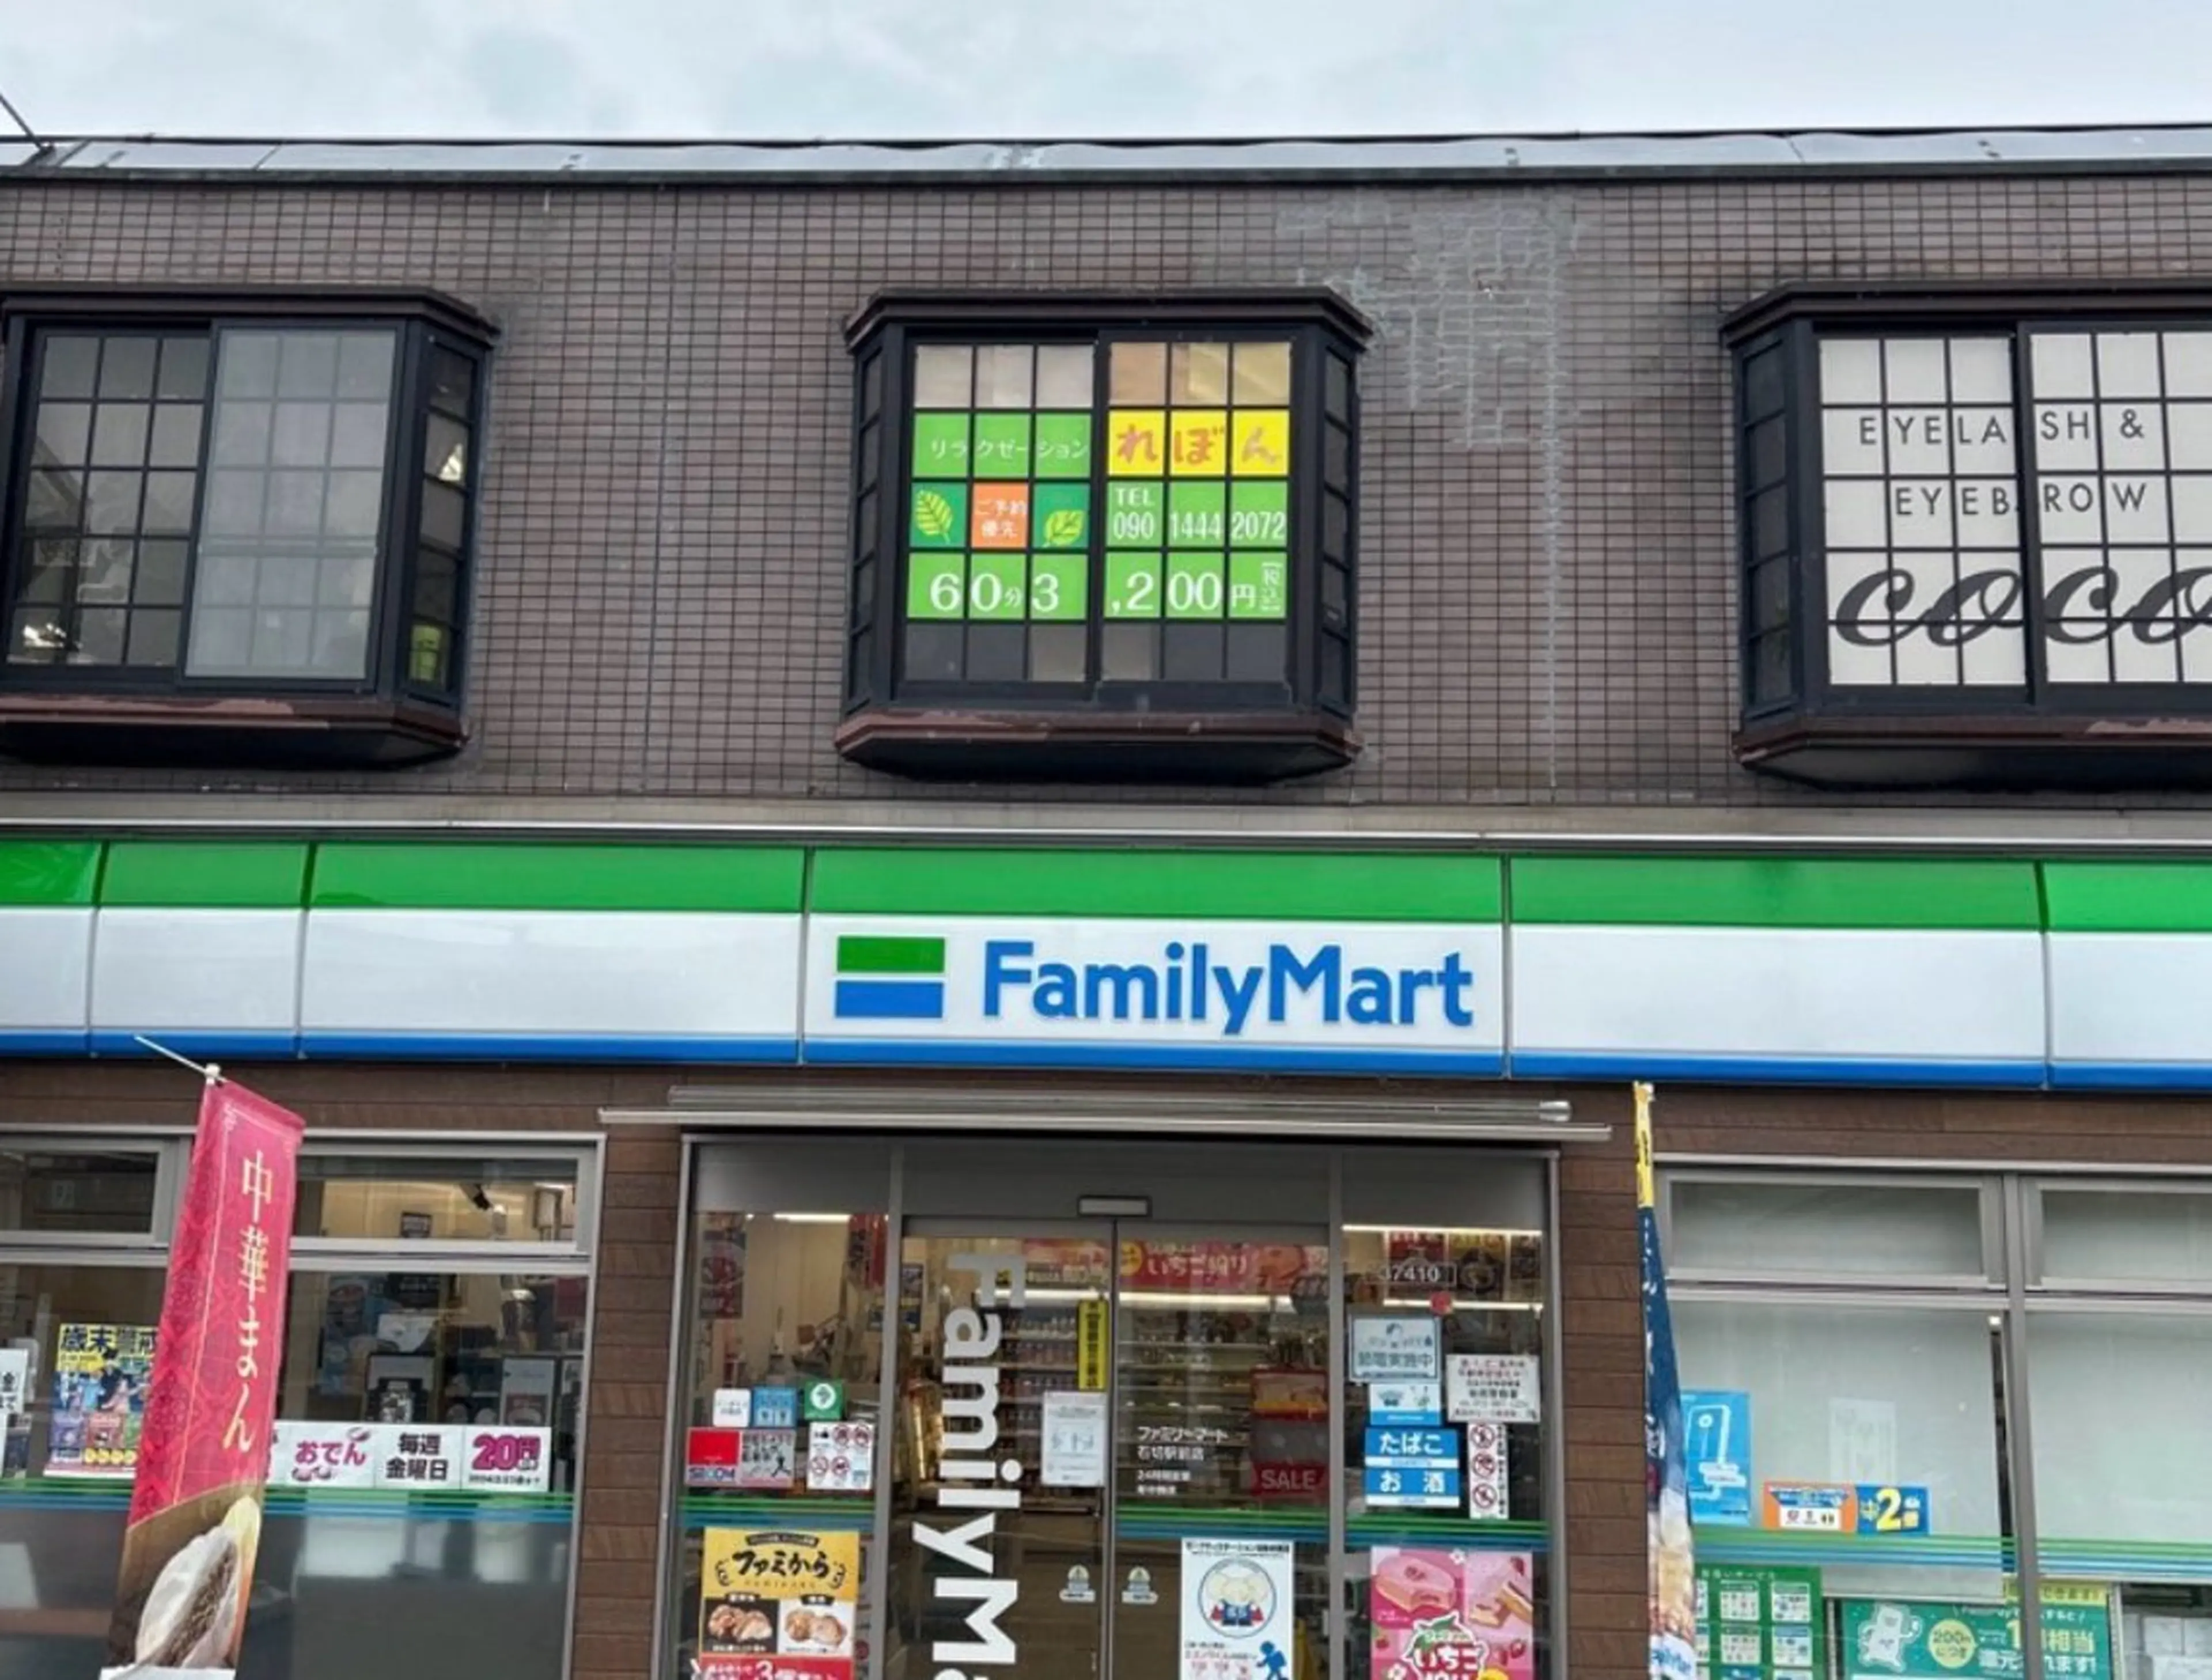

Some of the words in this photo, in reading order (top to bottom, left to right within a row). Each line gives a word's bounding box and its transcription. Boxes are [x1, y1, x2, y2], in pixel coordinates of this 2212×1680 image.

[1859, 412, 2090, 445] EYELASH
[2119, 409, 2145, 439] &
[1116, 424, 1277, 464] れぼん
[1116, 488, 1153, 506] TEL
[1896, 483, 2147, 516] EYEBROW
[1113, 512, 1154, 539] 090
[1171, 512, 1221, 539] 1444
[1231, 511, 1285, 539] 2072
[983, 940, 1474, 1035] FamilyMart
[223, 1149, 272, 1453] 中華まん
[295, 1440, 366, 1466] おでん
[397, 1433, 441, 1455] 毎週
[1380, 1432, 1444, 1455] たばこ
[385, 1457, 448, 1480] 金曜日
[911, 1254, 1026, 1680] FamilyM
[1261, 1469, 1316, 1490] SALE
[732, 1550, 830, 1579] ファミから
[1413, 1644, 1478, 1671] いちご
